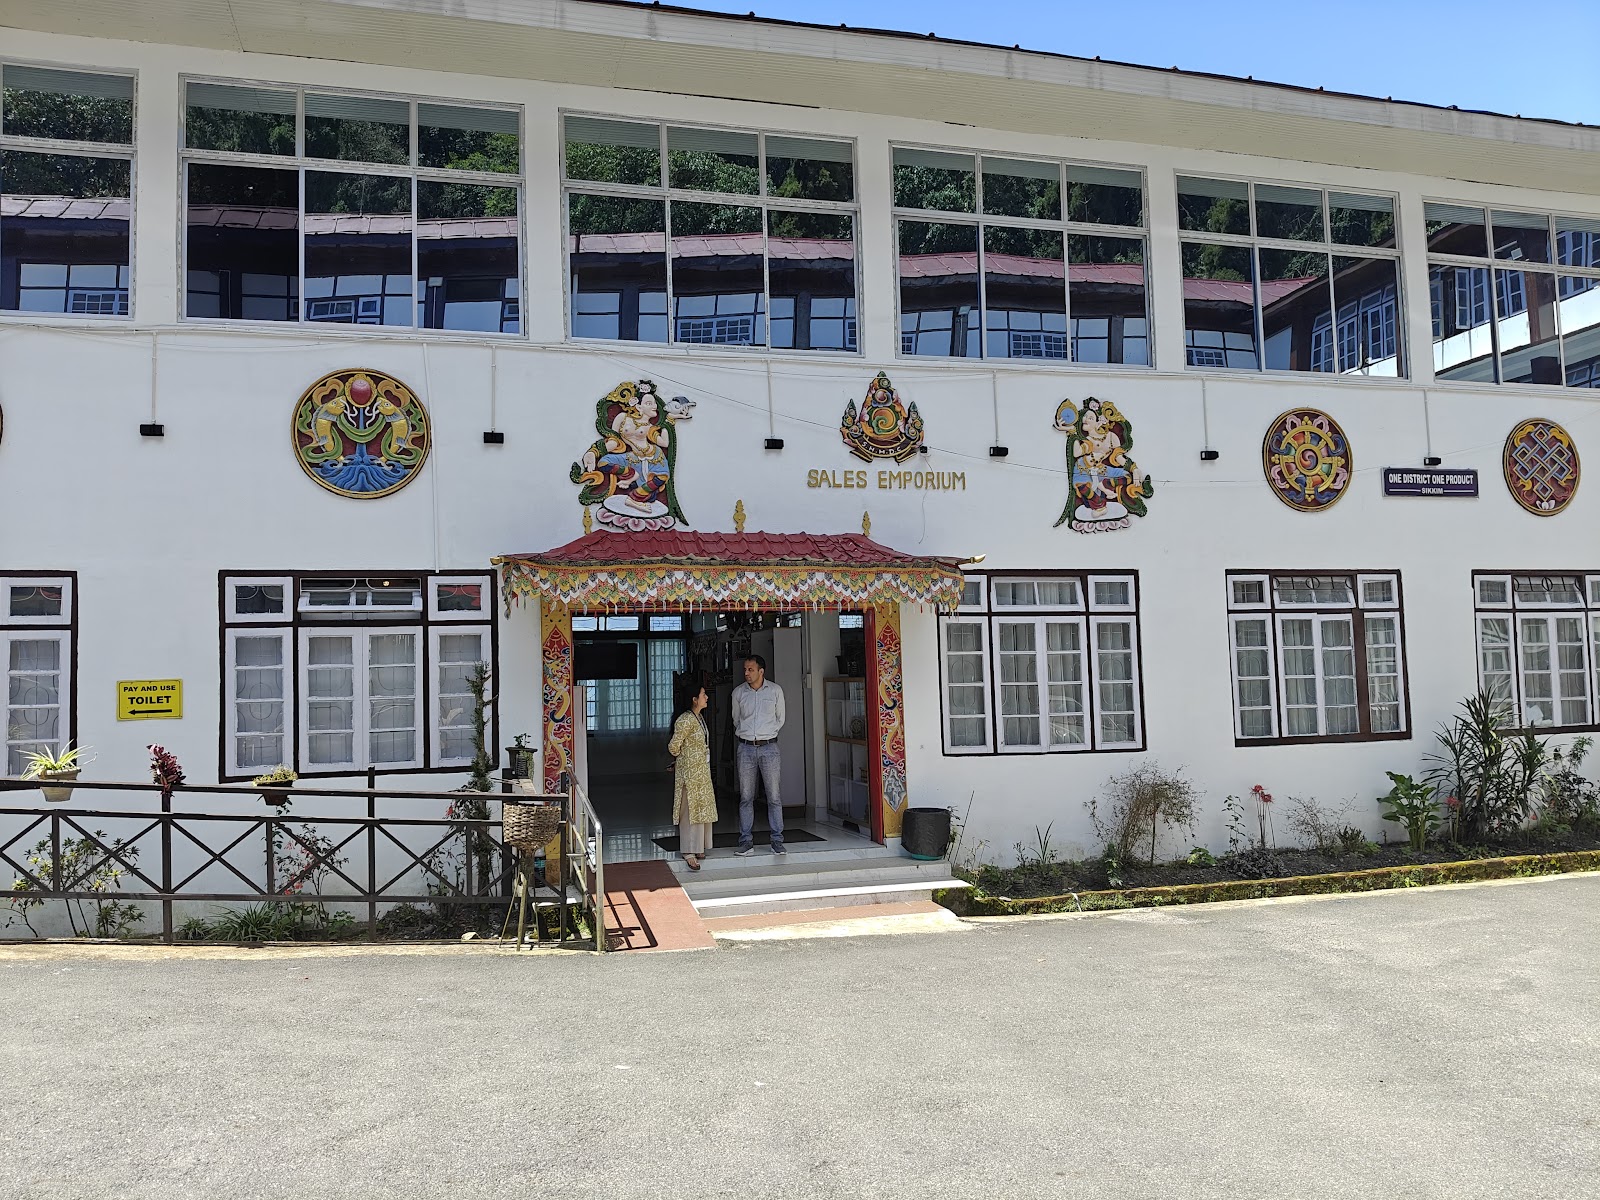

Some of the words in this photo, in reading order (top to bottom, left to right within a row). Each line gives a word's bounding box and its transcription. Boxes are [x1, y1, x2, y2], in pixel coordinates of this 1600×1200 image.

[807, 469, 867, 488] SALES
[878, 470, 966, 490] EMPORIUM
[1388, 473, 1402, 483] ONE
[1403, 474, 1430, 484] DISTRICT
[1432, 474, 1445, 484] ONE
[1446, 475, 1473, 484] PRODUCT
[128, 695, 171, 704] TOILET
